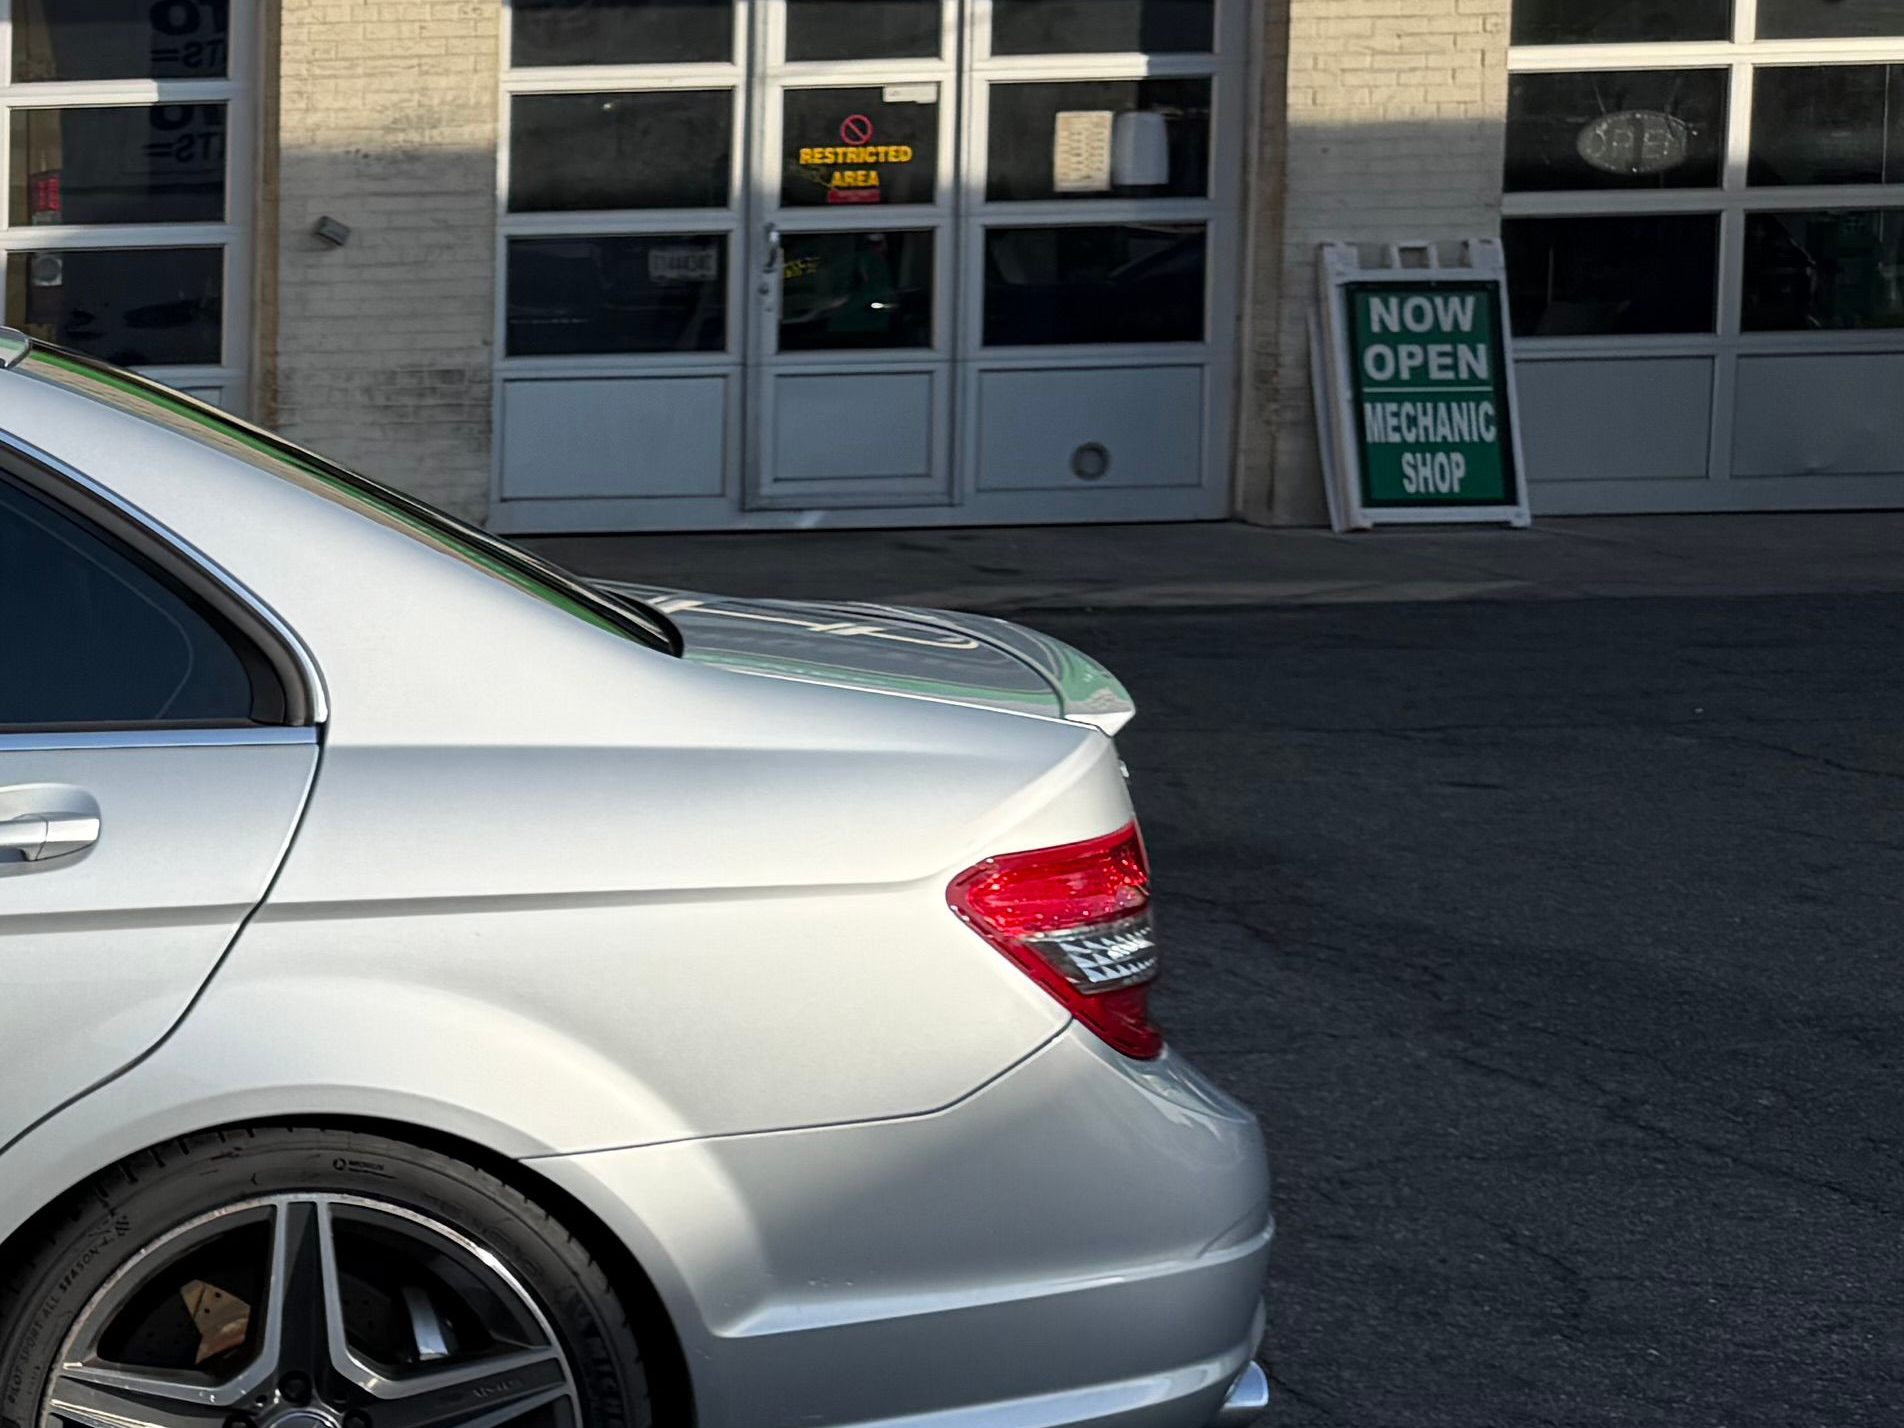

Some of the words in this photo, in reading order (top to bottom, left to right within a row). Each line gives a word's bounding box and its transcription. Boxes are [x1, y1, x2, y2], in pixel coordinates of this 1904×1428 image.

[800, 146, 912, 164] RESTRICTED
[831, 171, 880, 187] AREA
[1369, 295, 1475, 333] NOW
[1363, 343, 1488, 381] OPEN
[1364, 400, 1497, 444] MECHANIC
[1401, 451, 1466, 494] SHOP
[56, 1245, 99, 1295] SEASON
